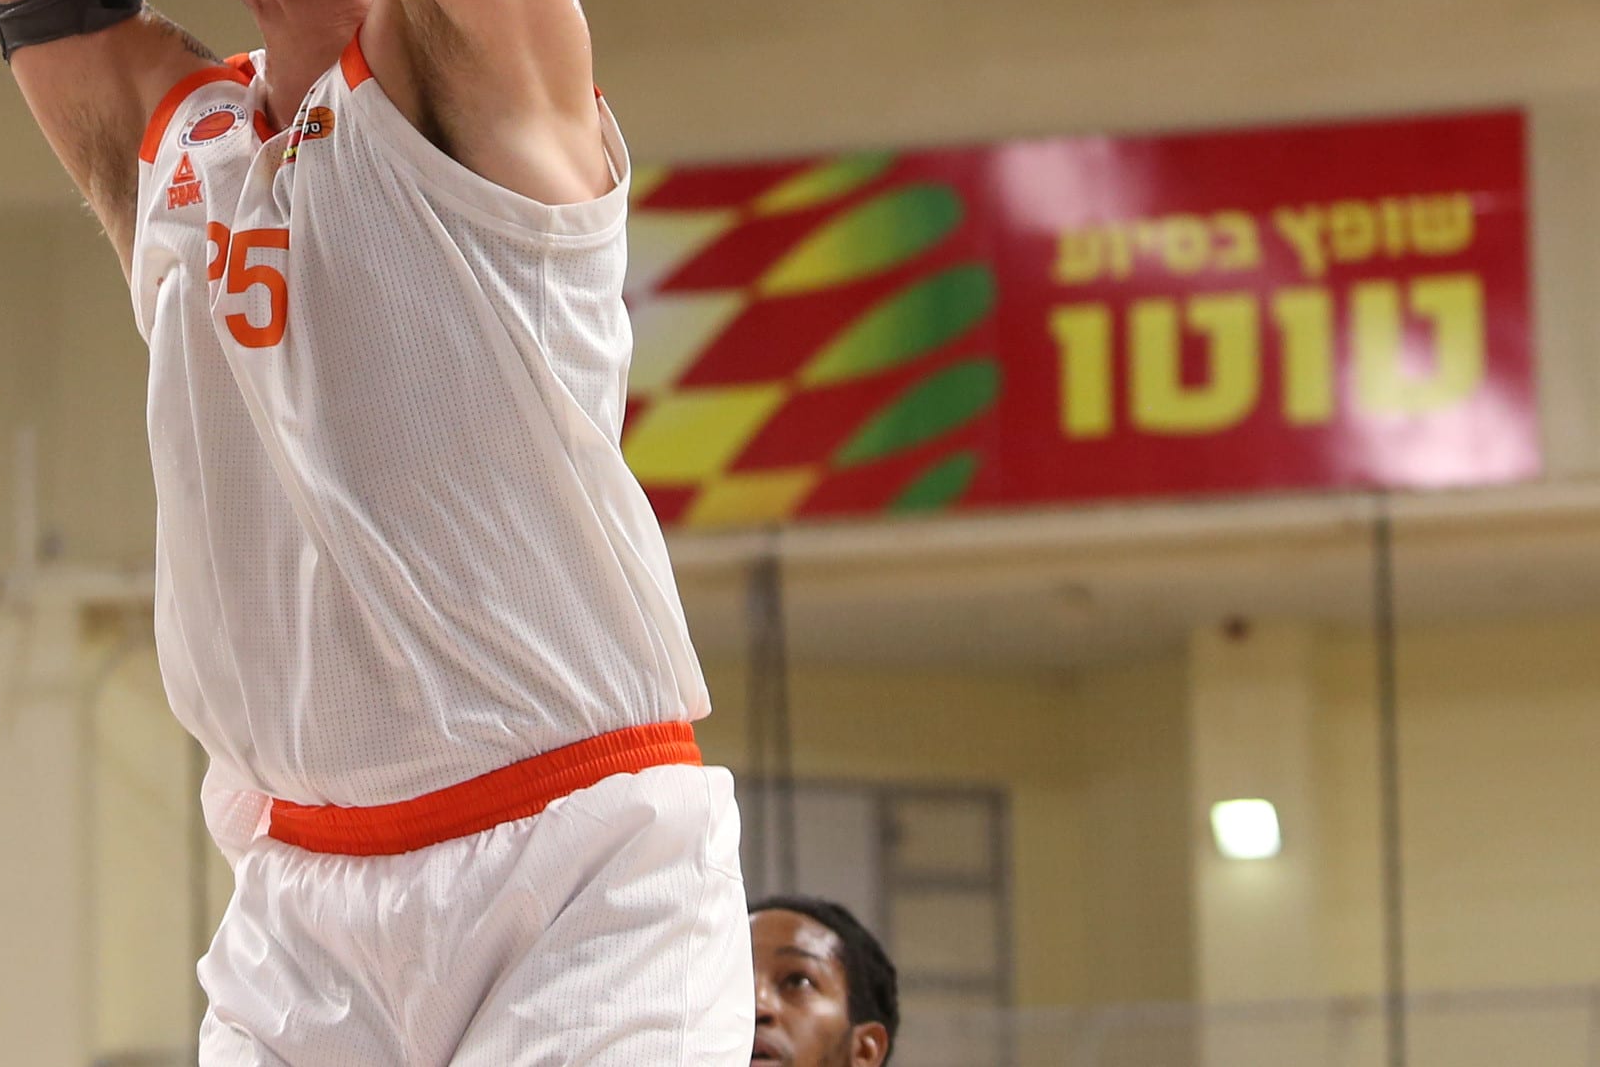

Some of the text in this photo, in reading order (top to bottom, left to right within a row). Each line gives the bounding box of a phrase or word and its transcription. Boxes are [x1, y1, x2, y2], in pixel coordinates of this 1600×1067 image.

[1051, 192, 1474, 286] שופץ בסיוע
[1050, 275, 1486, 440] טוטו
